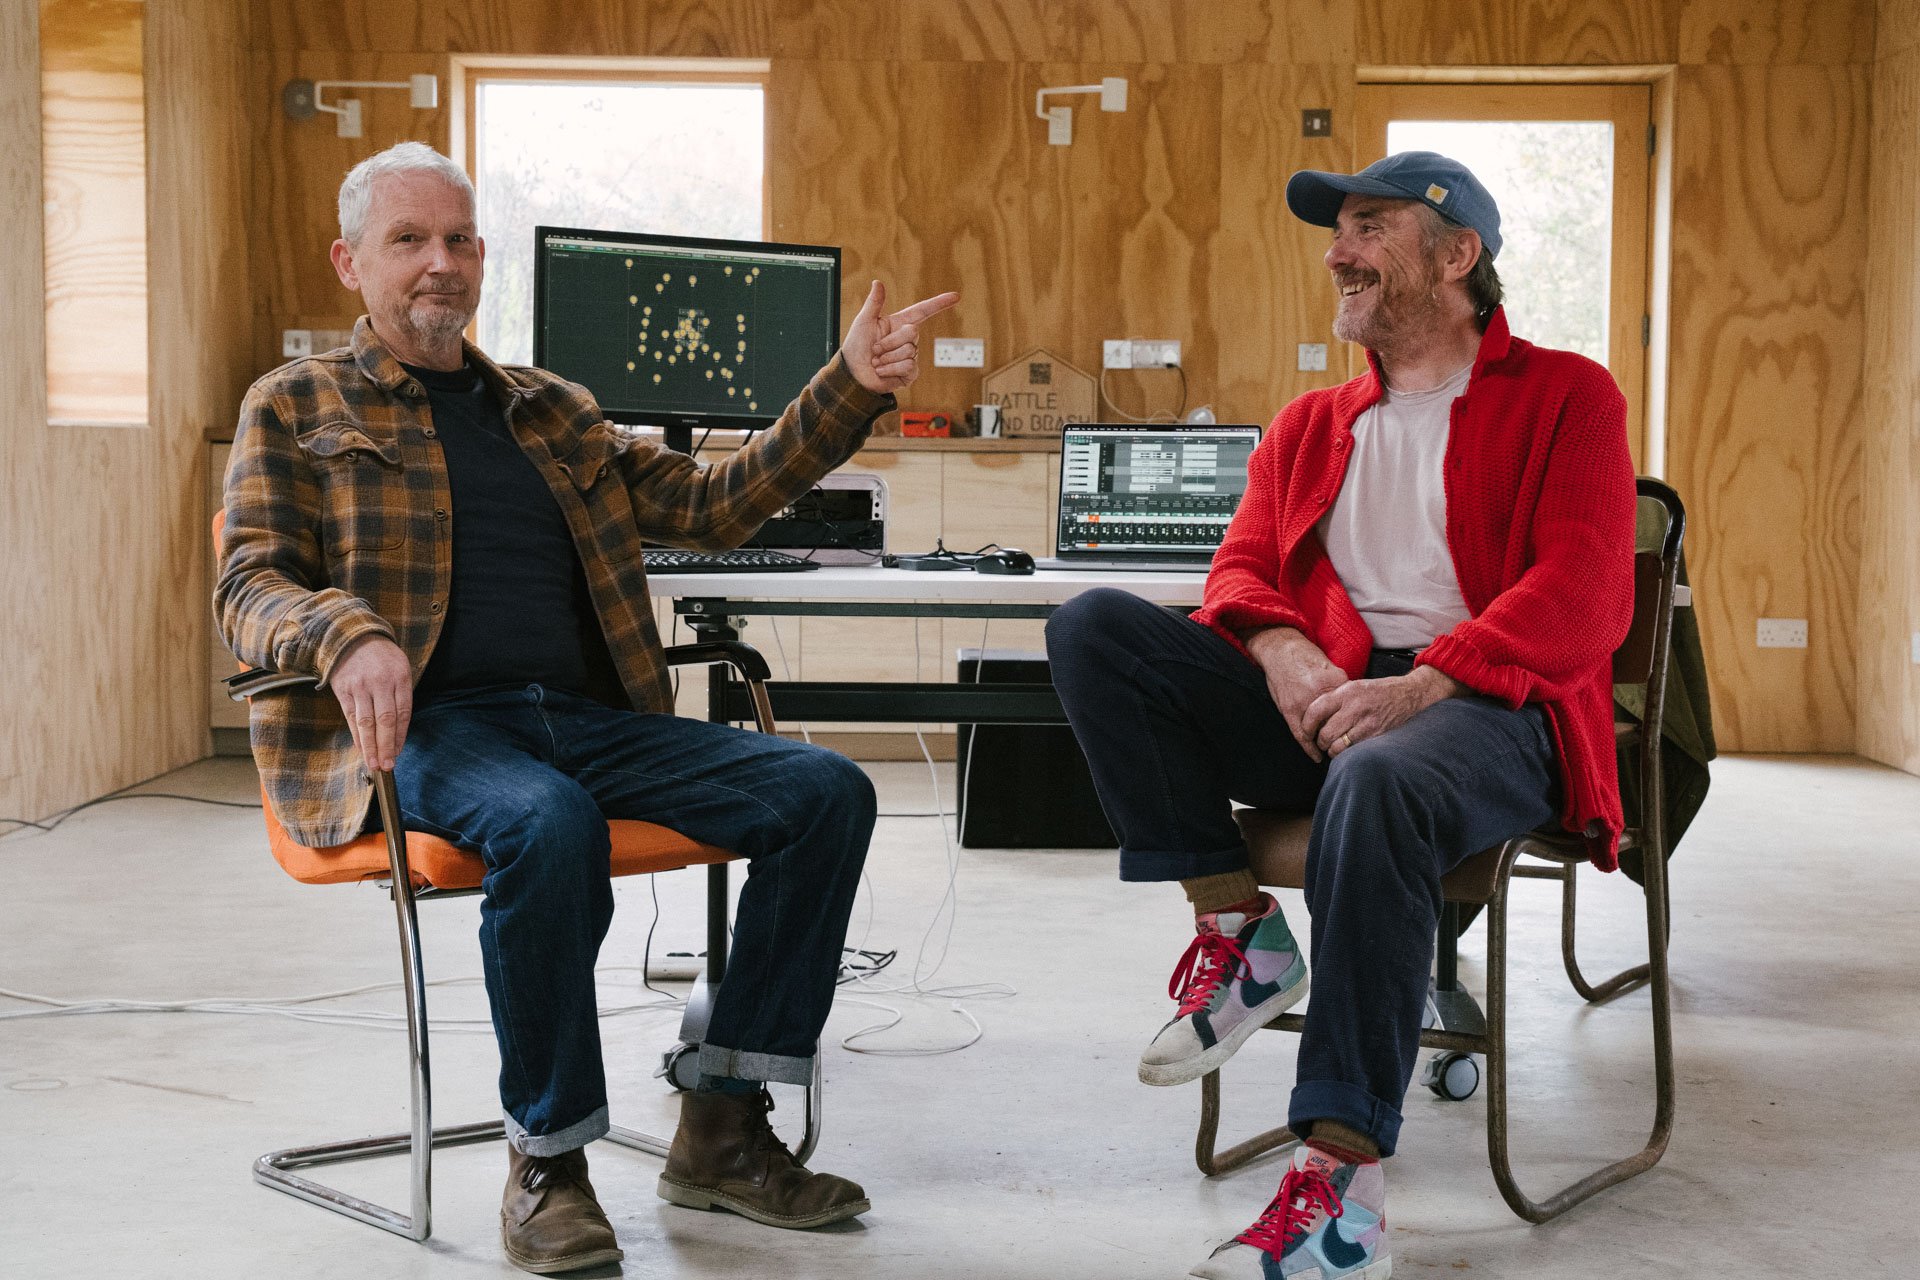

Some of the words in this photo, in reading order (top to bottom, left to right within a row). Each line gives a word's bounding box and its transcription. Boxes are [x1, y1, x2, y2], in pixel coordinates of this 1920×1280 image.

[989, 392, 1058, 410] RATTLE
[1002, 416, 1024, 431] ND
[1310, 1155, 1329, 1166] NIKE
